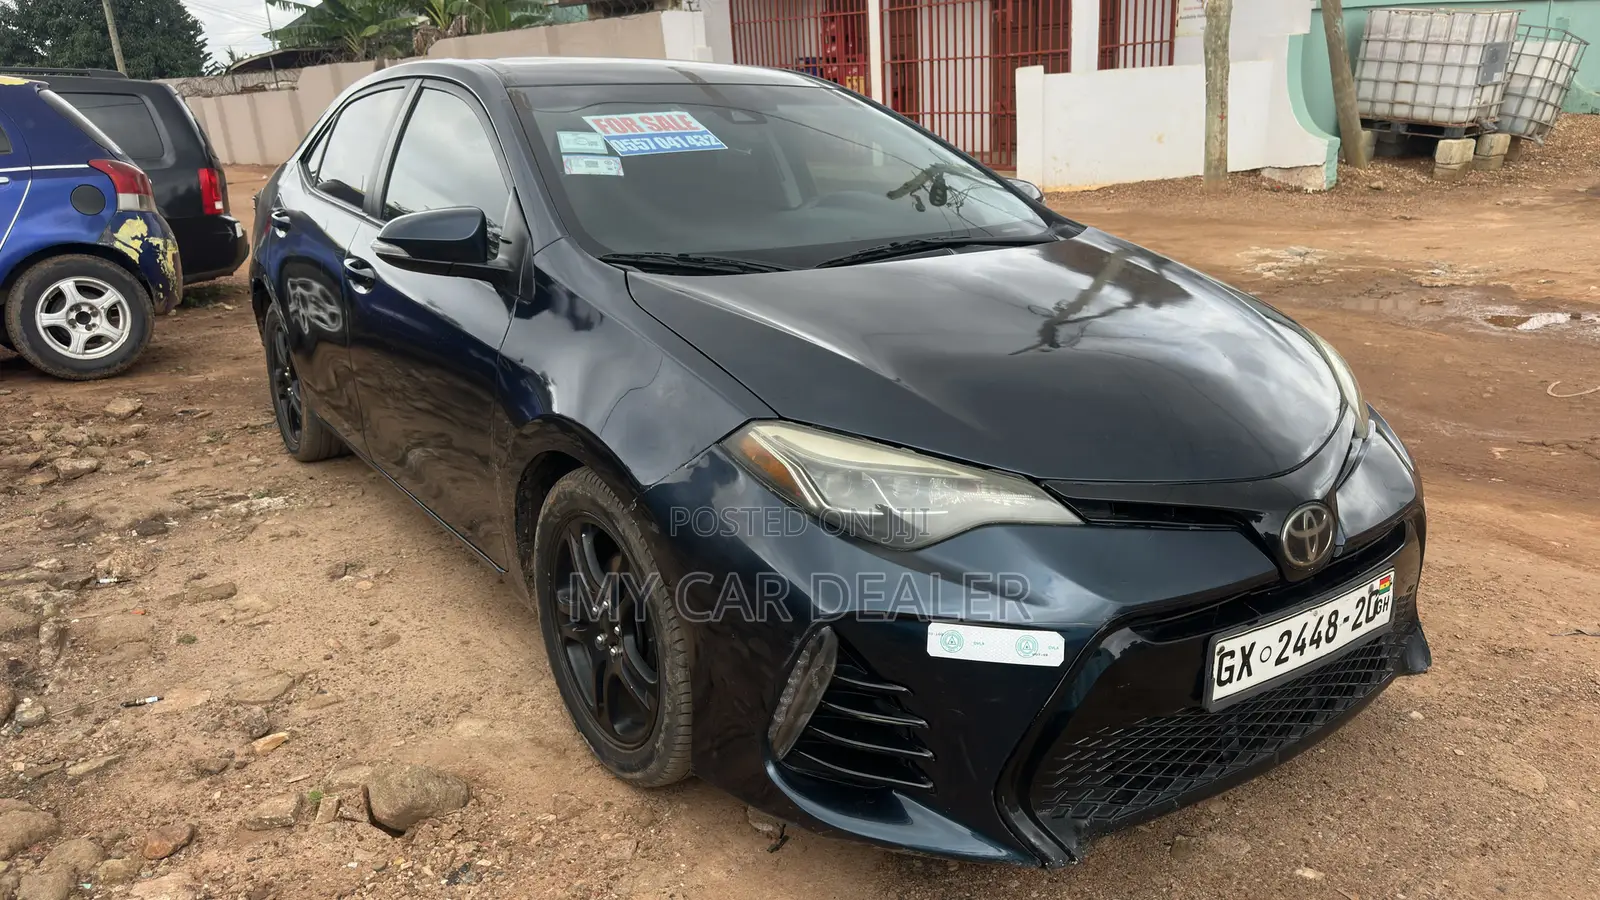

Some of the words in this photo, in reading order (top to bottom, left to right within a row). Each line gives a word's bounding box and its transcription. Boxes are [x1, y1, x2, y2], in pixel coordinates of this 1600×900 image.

[591, 117, 647, 135] FOR
[638, 114, 701, 132] SALE
[609, 138, 656, 152] 0557
[653, 136, 690, 149] 041
[685, 134, 721, 147] 432
[1375, 595, 1390, 616] GH
[1216, 641, 1257, 688] GX
